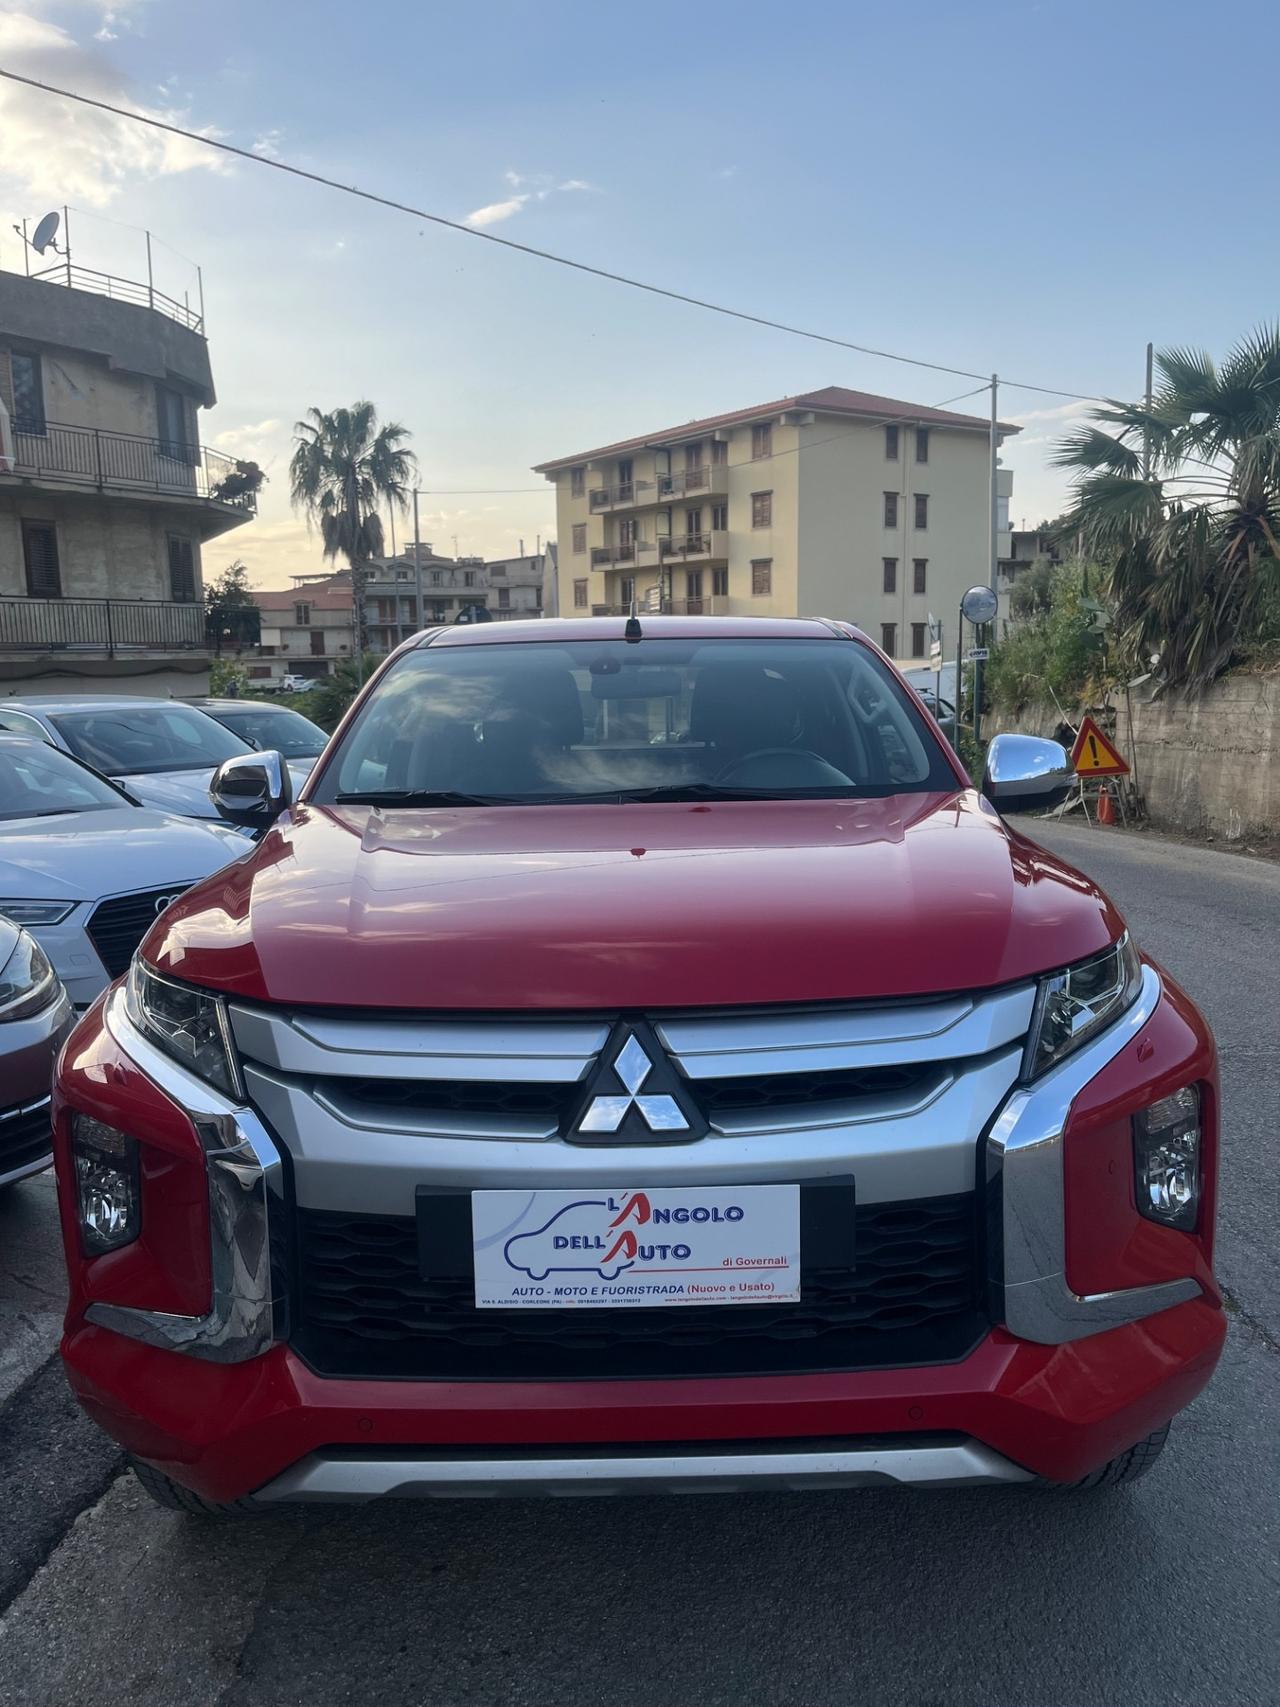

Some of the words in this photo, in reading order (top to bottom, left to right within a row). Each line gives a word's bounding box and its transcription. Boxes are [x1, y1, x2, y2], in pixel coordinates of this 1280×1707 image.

[722, 1258, 732, 1266] di
[736, 1256, 787, 1266] Governali
[512, 1287, 544, 1296] AUTO
[554, 1287, 588, 1296] MOTO
[591, 1287, 598, 1295] E
[601, 1285, 684, 1295] FUORISTRADA
[688, 1284, 726, 1294] (Nuovo
[739, 1282, 775, 1292] Usato)
